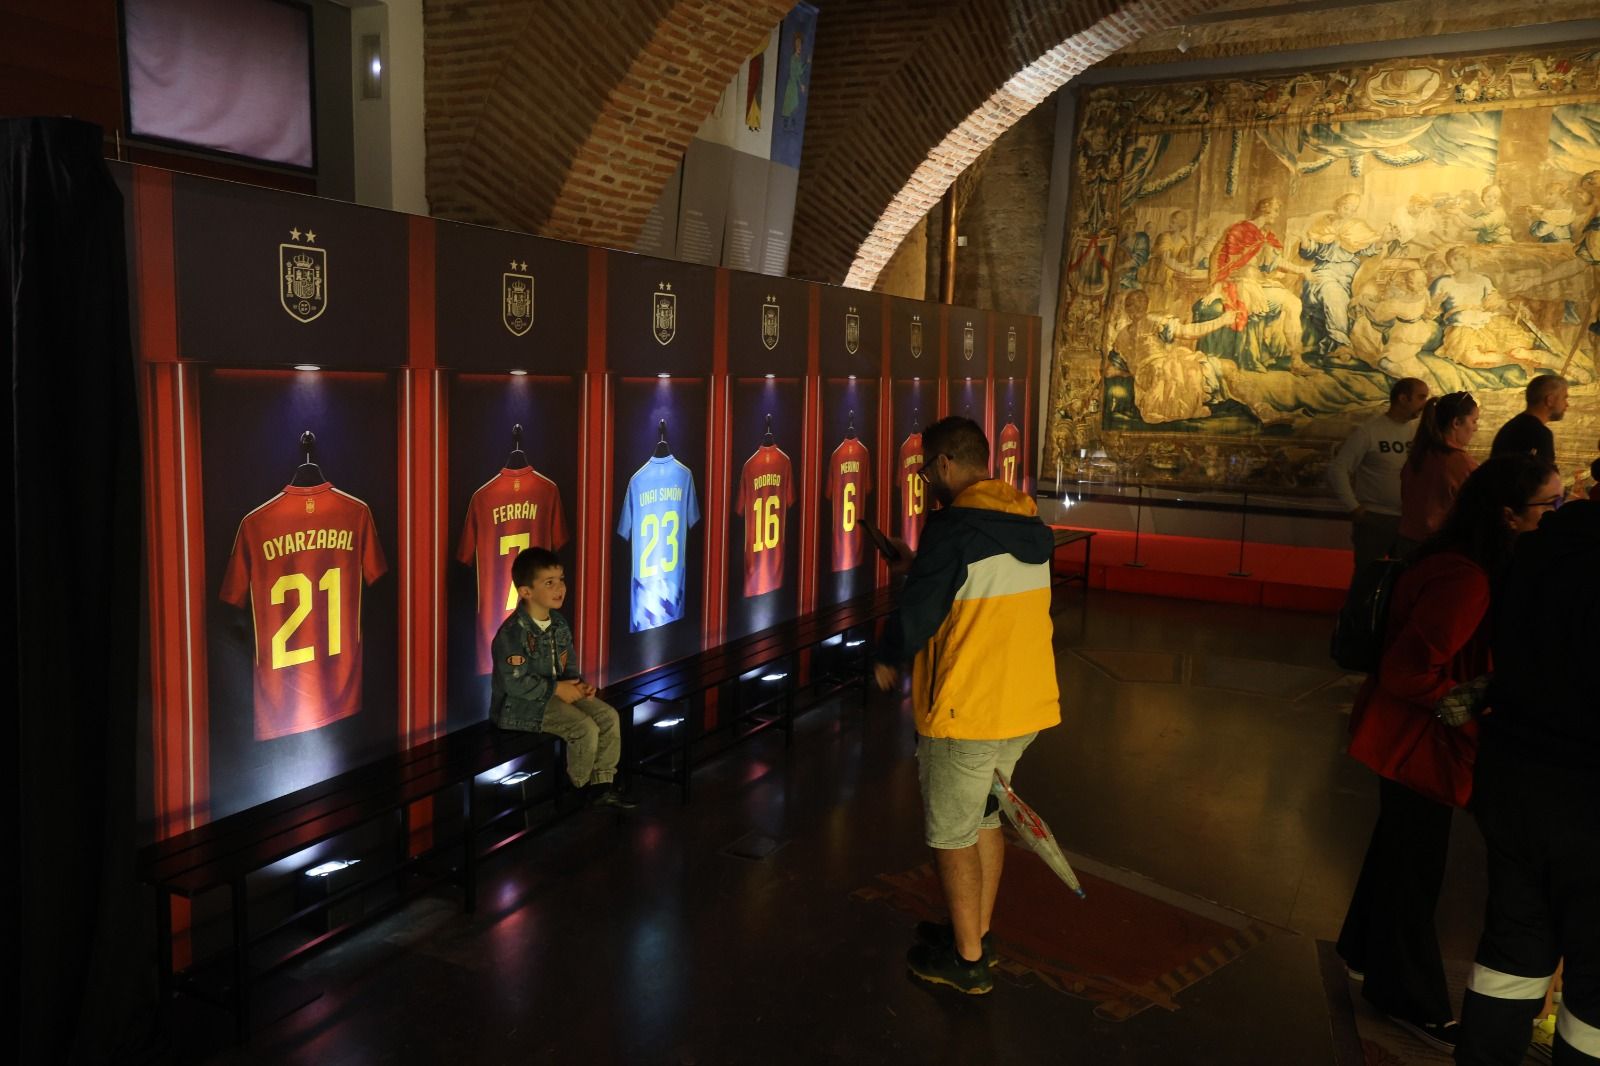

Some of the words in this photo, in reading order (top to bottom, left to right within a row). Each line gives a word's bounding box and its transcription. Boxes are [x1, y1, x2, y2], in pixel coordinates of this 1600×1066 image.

[754, 474, 780, 490] RODRIGO
[1004, 455, 1015, 486] 17
[493, 501, 537, 524] FERRÁN
[640, 488, 657, 507] UNAI
[843, 482, 856, 532] 6
[907, 473, 924, 517] 19
[263, 529, 353, 561] OYARZABAL
[640, 511, 679, 578] 23
[753, 495, 780, 553] 16
[500, 532, 530, 611] 7
[271, 567, 341, 670] 21
